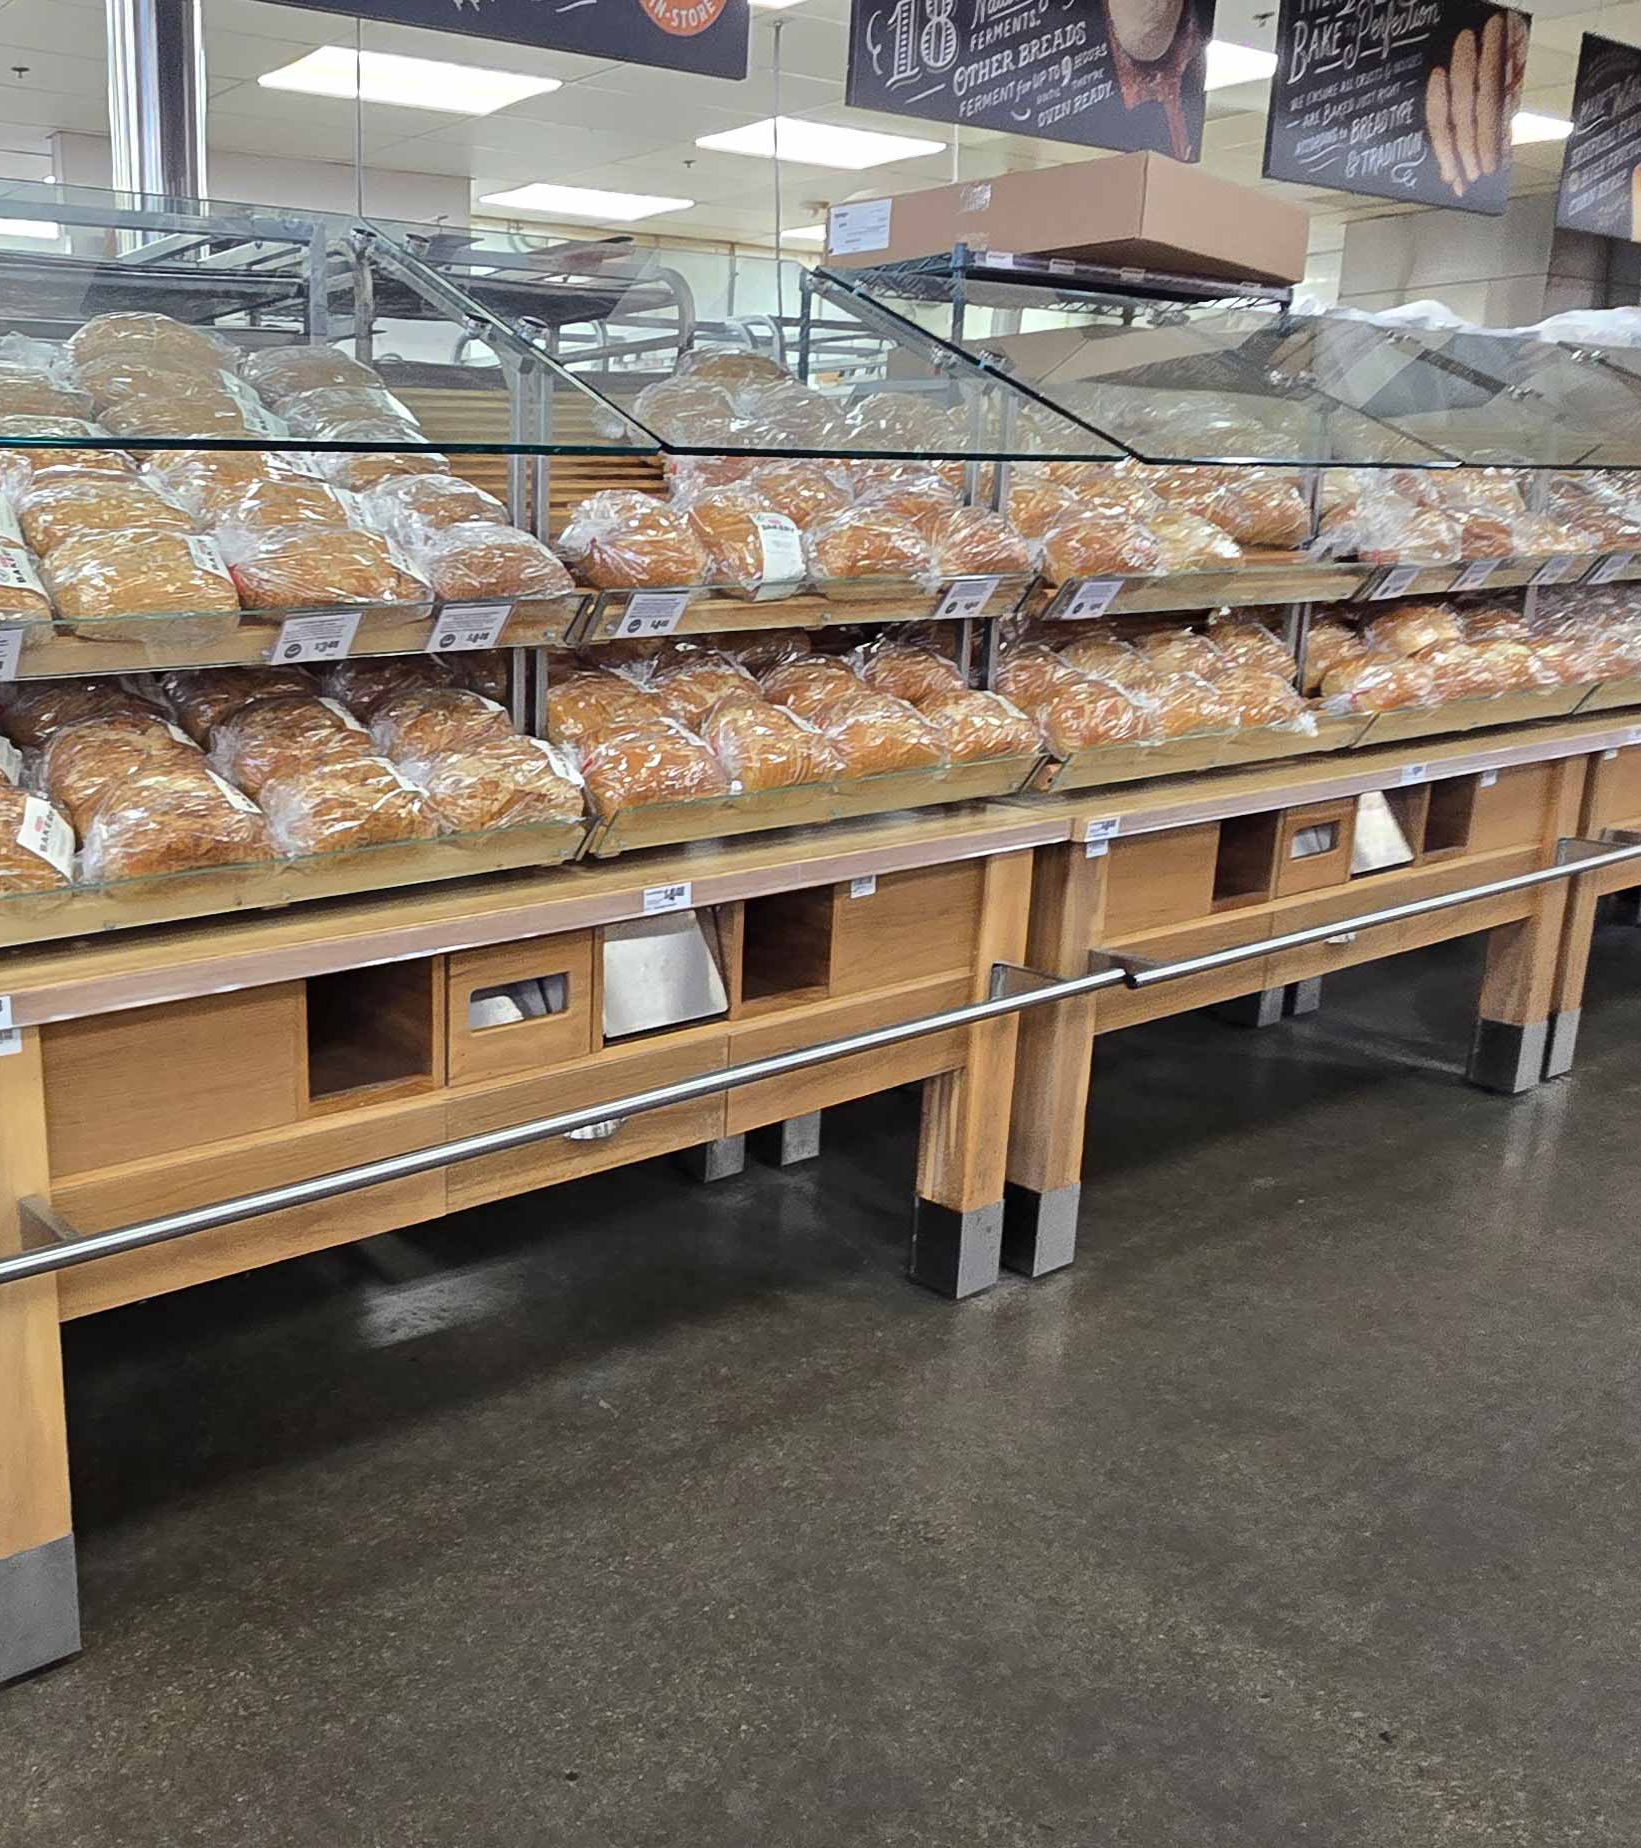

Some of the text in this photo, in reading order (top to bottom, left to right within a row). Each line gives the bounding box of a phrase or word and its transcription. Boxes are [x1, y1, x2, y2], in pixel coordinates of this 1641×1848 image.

[886, 0, 959, 89] 18
[970, 9, 1041, 52] FERMENTS.
[1287, 20, 1344, 85] BAKE
[953, 21, 1087, 96] OTHER BREADS
[959, 81, 1015, 118] FERMENT
[1032, 70, 1047, 90] UP
[1048, 64, 1060, 82] TO
[1061, 55, 1073, 87] 9
[1038, 80, 1114, 128] OVEN READY.
[1350, 112, 1388, 145] BREAD
[1360, 129, 1426, 177] TRADITION
